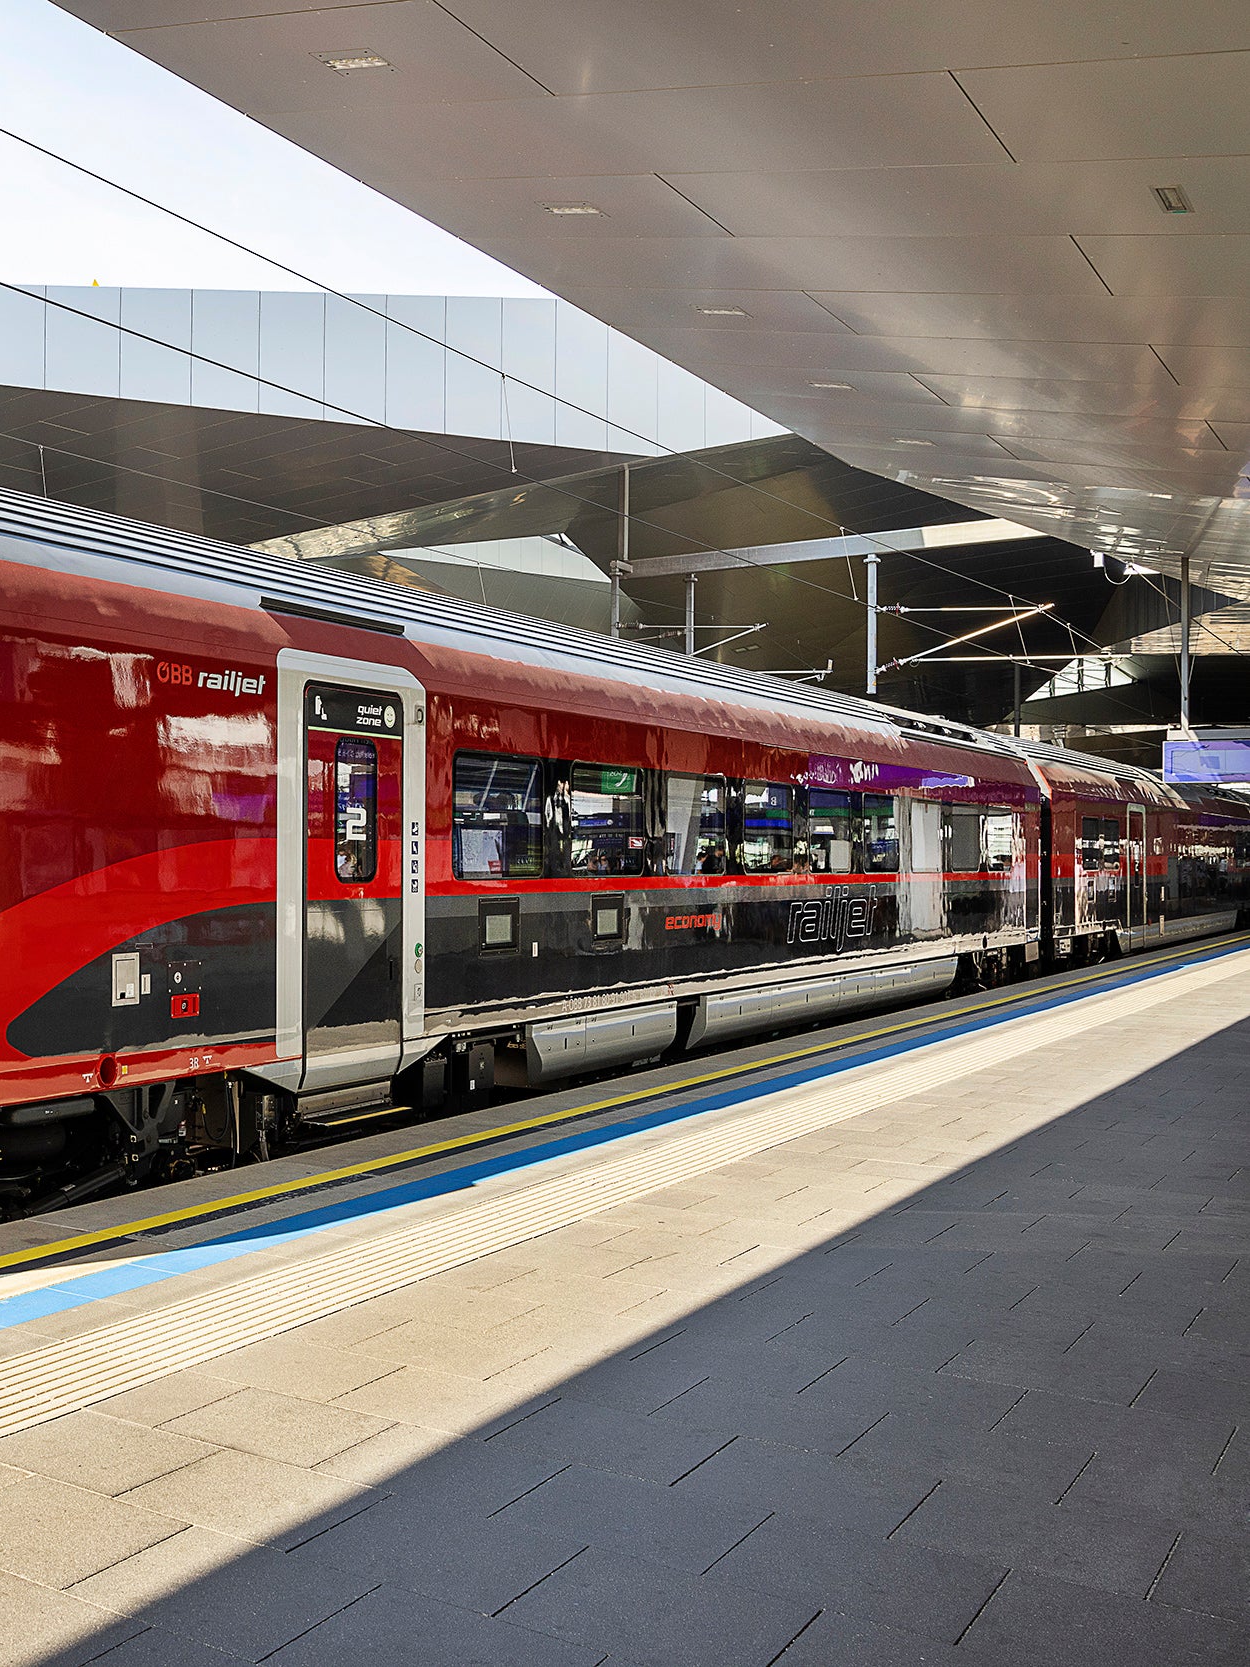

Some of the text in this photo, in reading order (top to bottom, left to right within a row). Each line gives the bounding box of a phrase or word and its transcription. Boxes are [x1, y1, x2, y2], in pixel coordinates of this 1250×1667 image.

[156, 661, 266, 697] ÖBB railjet
[356, 716, 382, 727] zone
[357, 704, 383, 716] quiet
[346, 807, 367, 840] 2
[665, 913, 722, 931] economy
[786, 885, 878, 952] railjet
